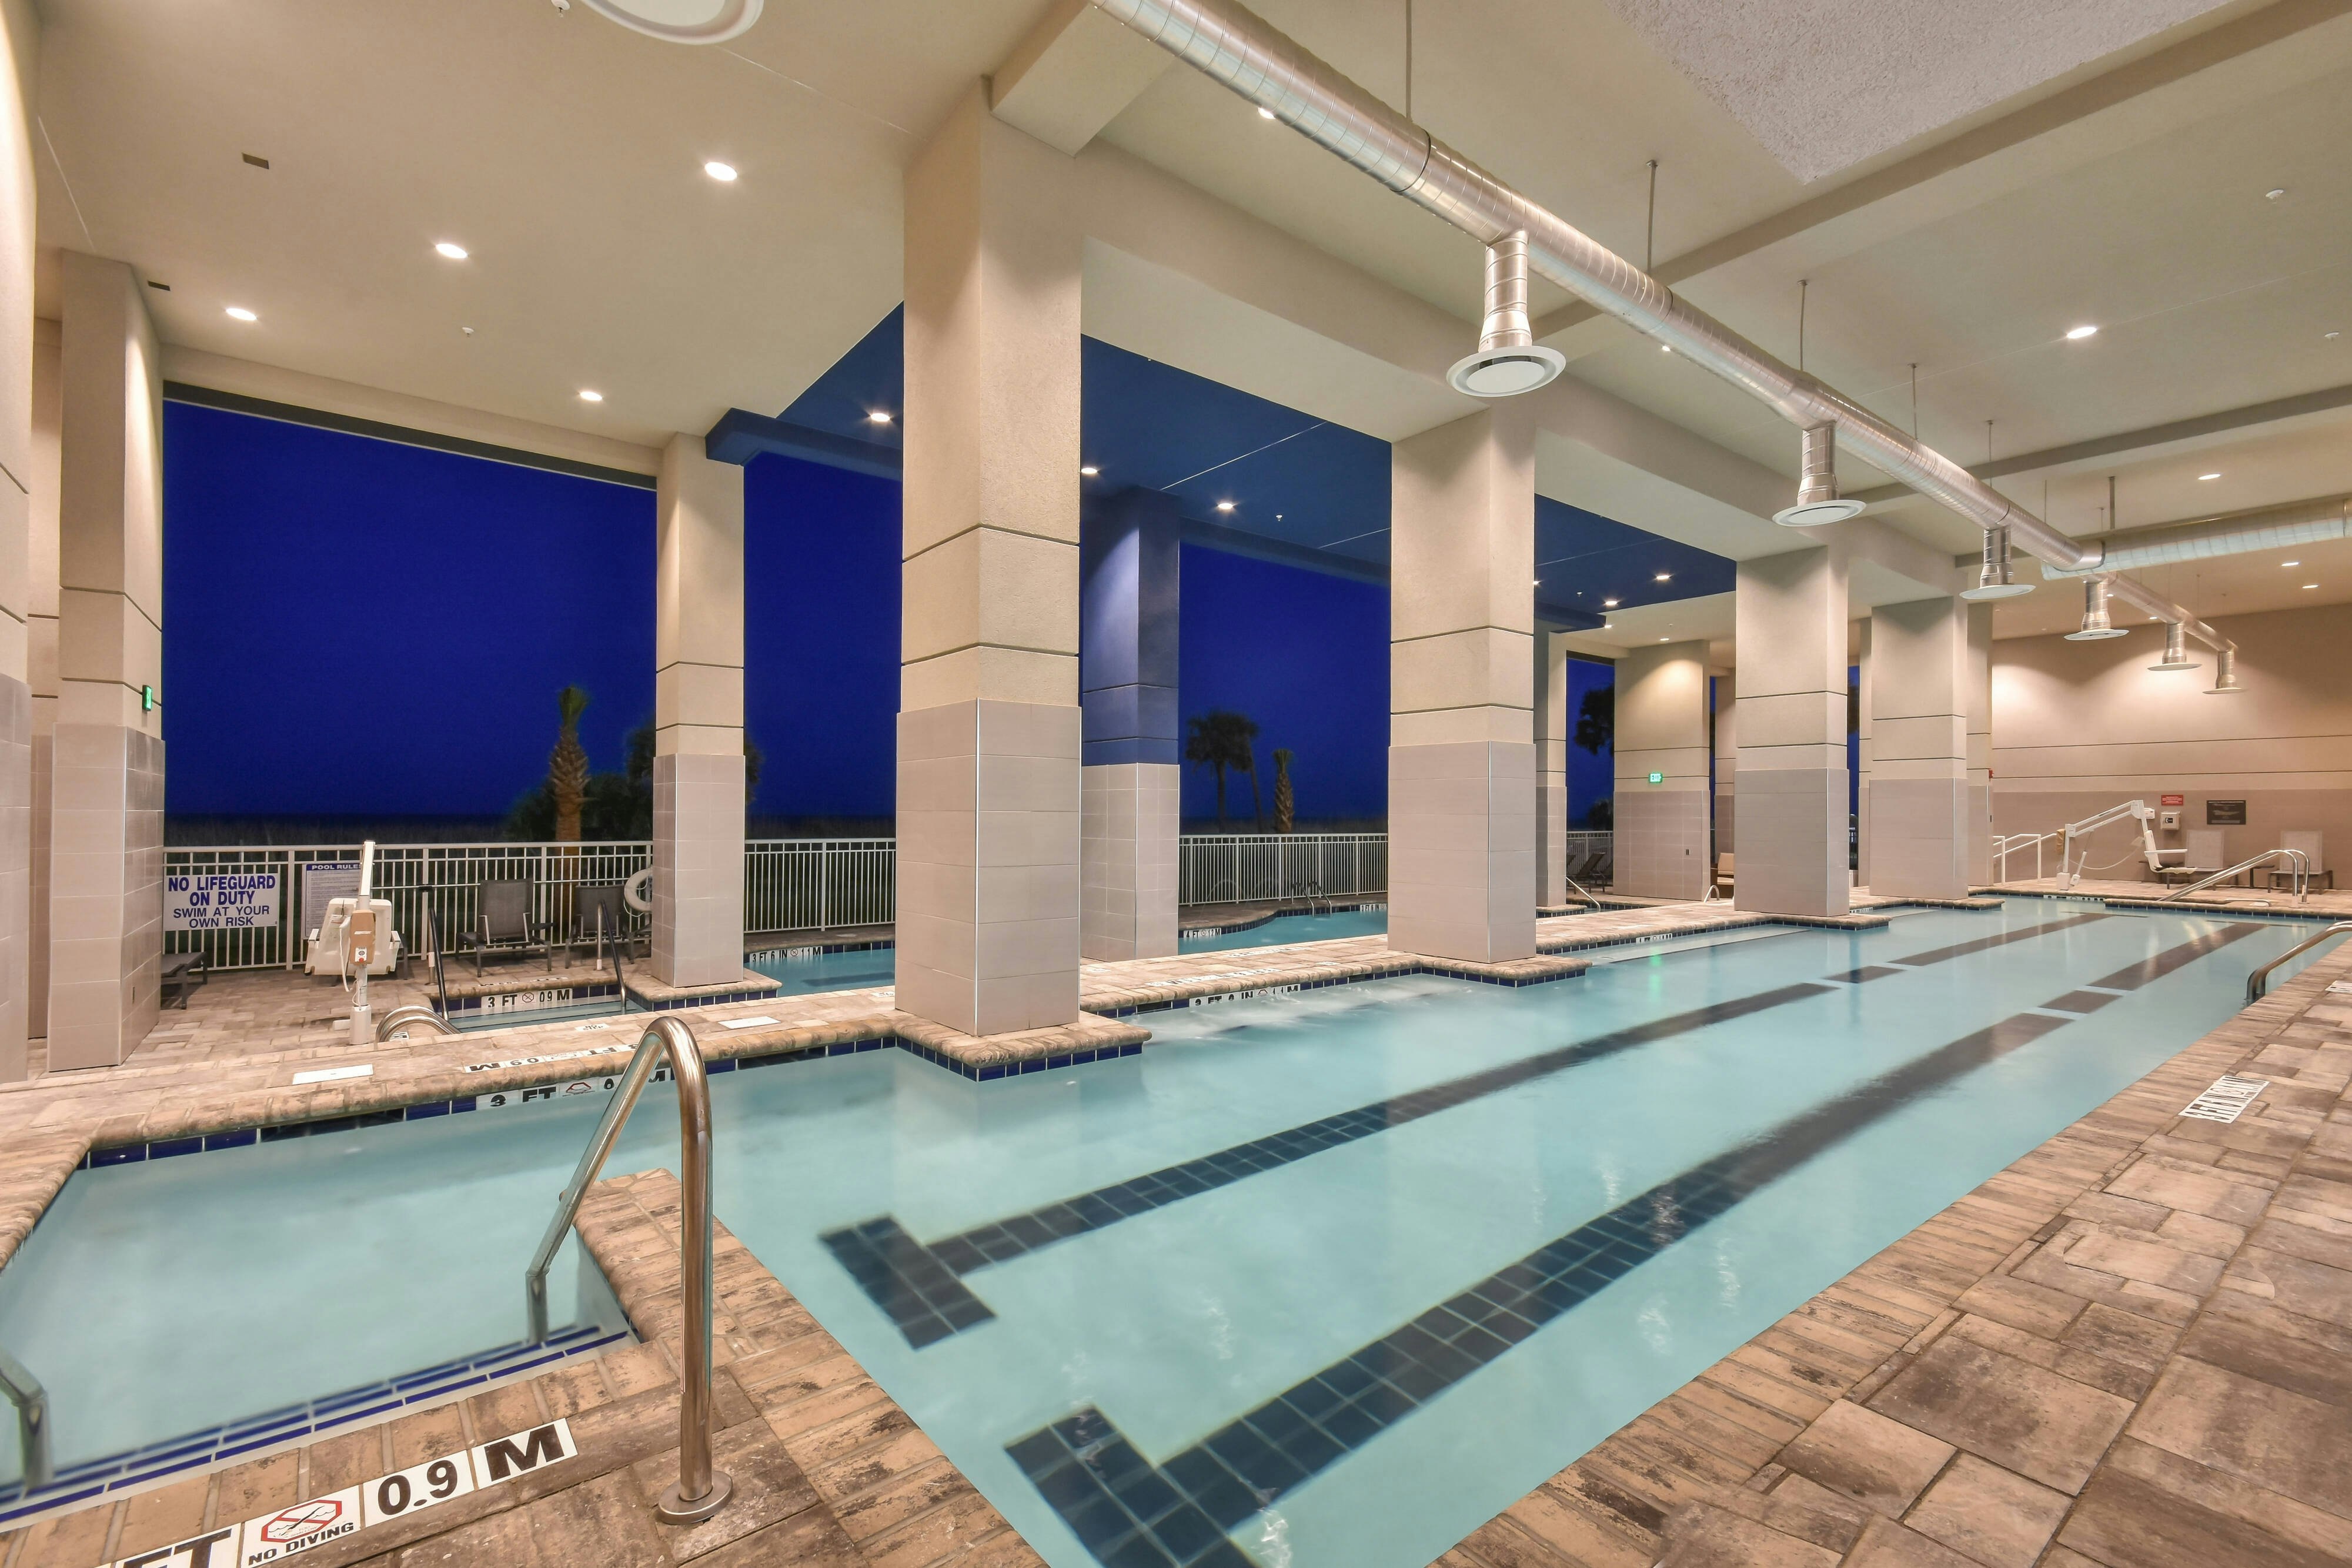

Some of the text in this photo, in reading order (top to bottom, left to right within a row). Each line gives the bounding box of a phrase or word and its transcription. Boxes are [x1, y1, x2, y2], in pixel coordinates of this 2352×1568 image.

[168, 875, 276, 892] NO LIFEGUARD
[189, 890, 255, 907] ON DUTY
[173, 905, 270, 918] SWIM AT YOUR
[189, 916, 254, 928] OWN RISK
[1192, 930, 1200, 938] FT
[1215, 928, 1221, 936] M
[752, 954, 757, 962] 3
[759, 952, 767, 961] FT
[770, 951, 776, 959] 6
[779, 950, 788, 958] IN
[813, 947, 821, 955] M
[488, 997, 496, 1008] 3
[502, 994, 518, 1007] FT
[557, 989, 570, 1001] M
[1241, 991, 1254, 999] IN
[1287, 985, 1298, 993] M
[587, 1047, 617, 1056] FT
[469, 1062, 501, 1072] M
[522, 1086, 557, 1103] FT
[377, 1424, 565, 1516] 0.9 M
[248, 1549, 278, 1566] NO
[286, 1522, 355, 1553] DIVING
